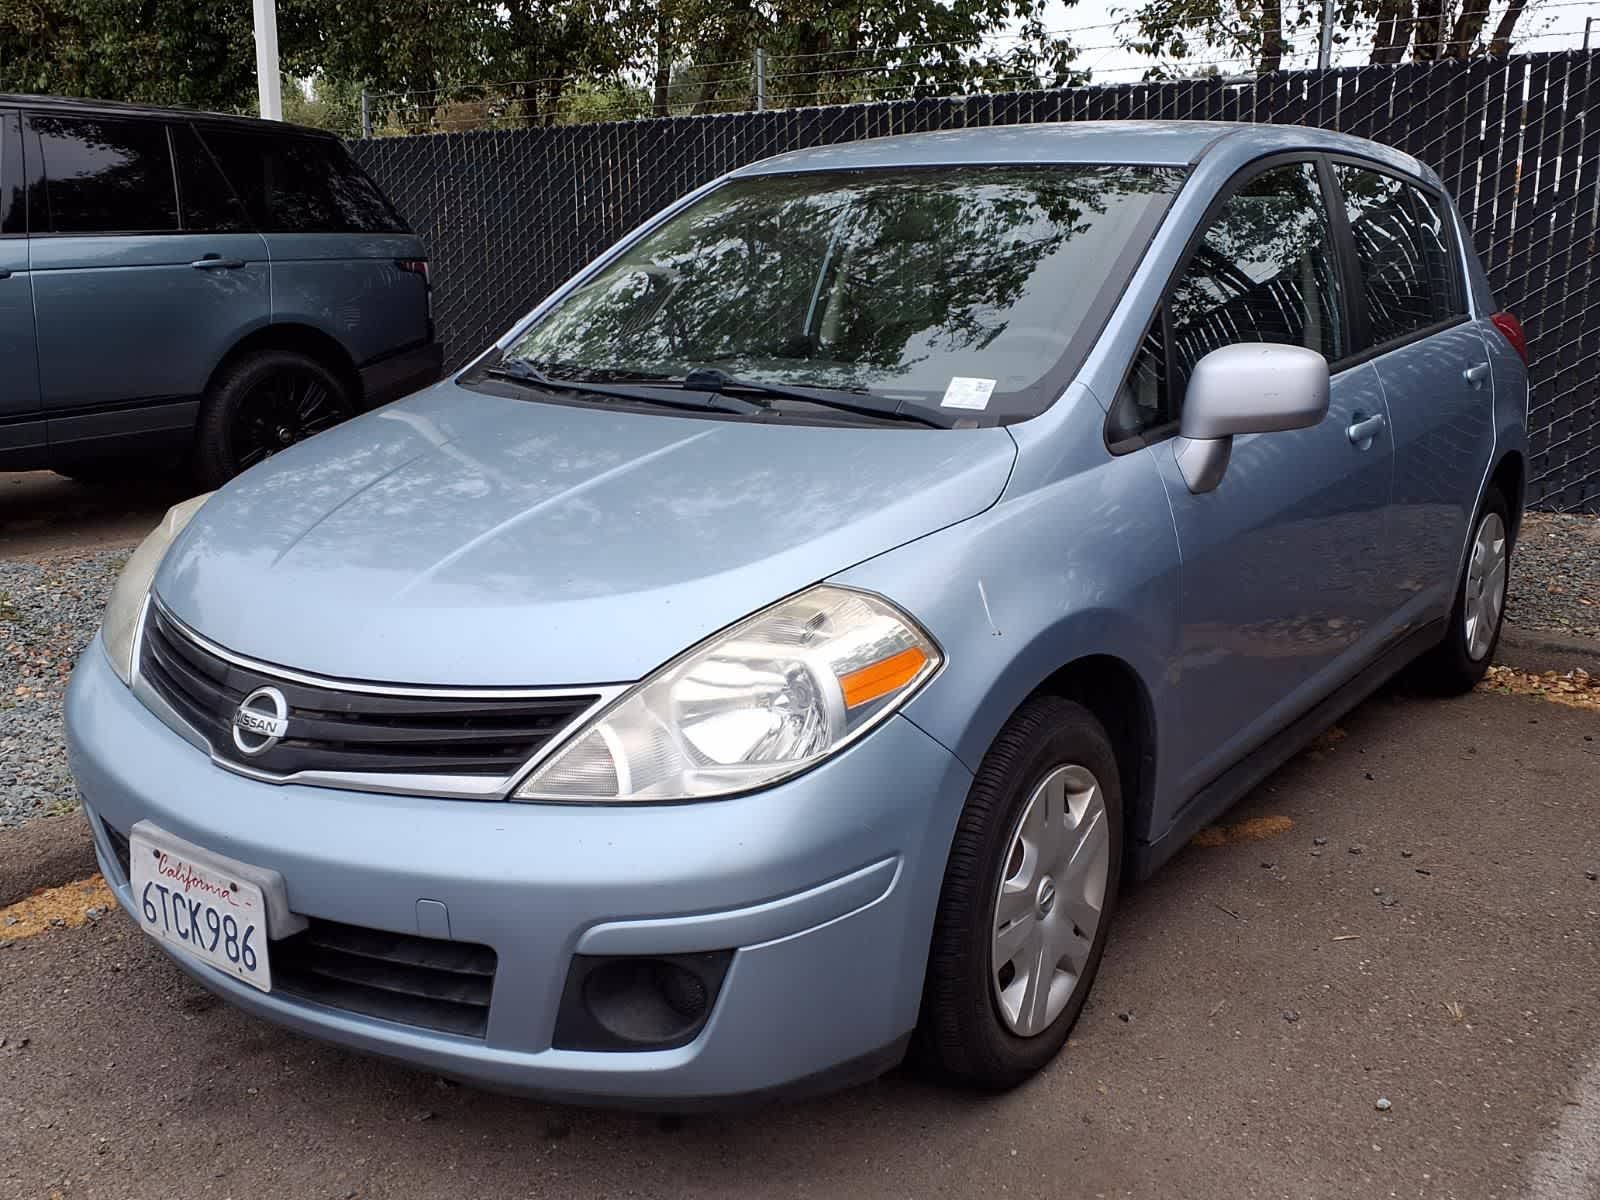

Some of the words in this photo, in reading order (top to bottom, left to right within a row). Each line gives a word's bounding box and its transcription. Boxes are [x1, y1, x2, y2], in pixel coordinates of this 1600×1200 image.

[234, 711, 277, 733] NISSAN
[158, 854, 238, 906] California
[143, 881, 256, 971] 6TCK986
